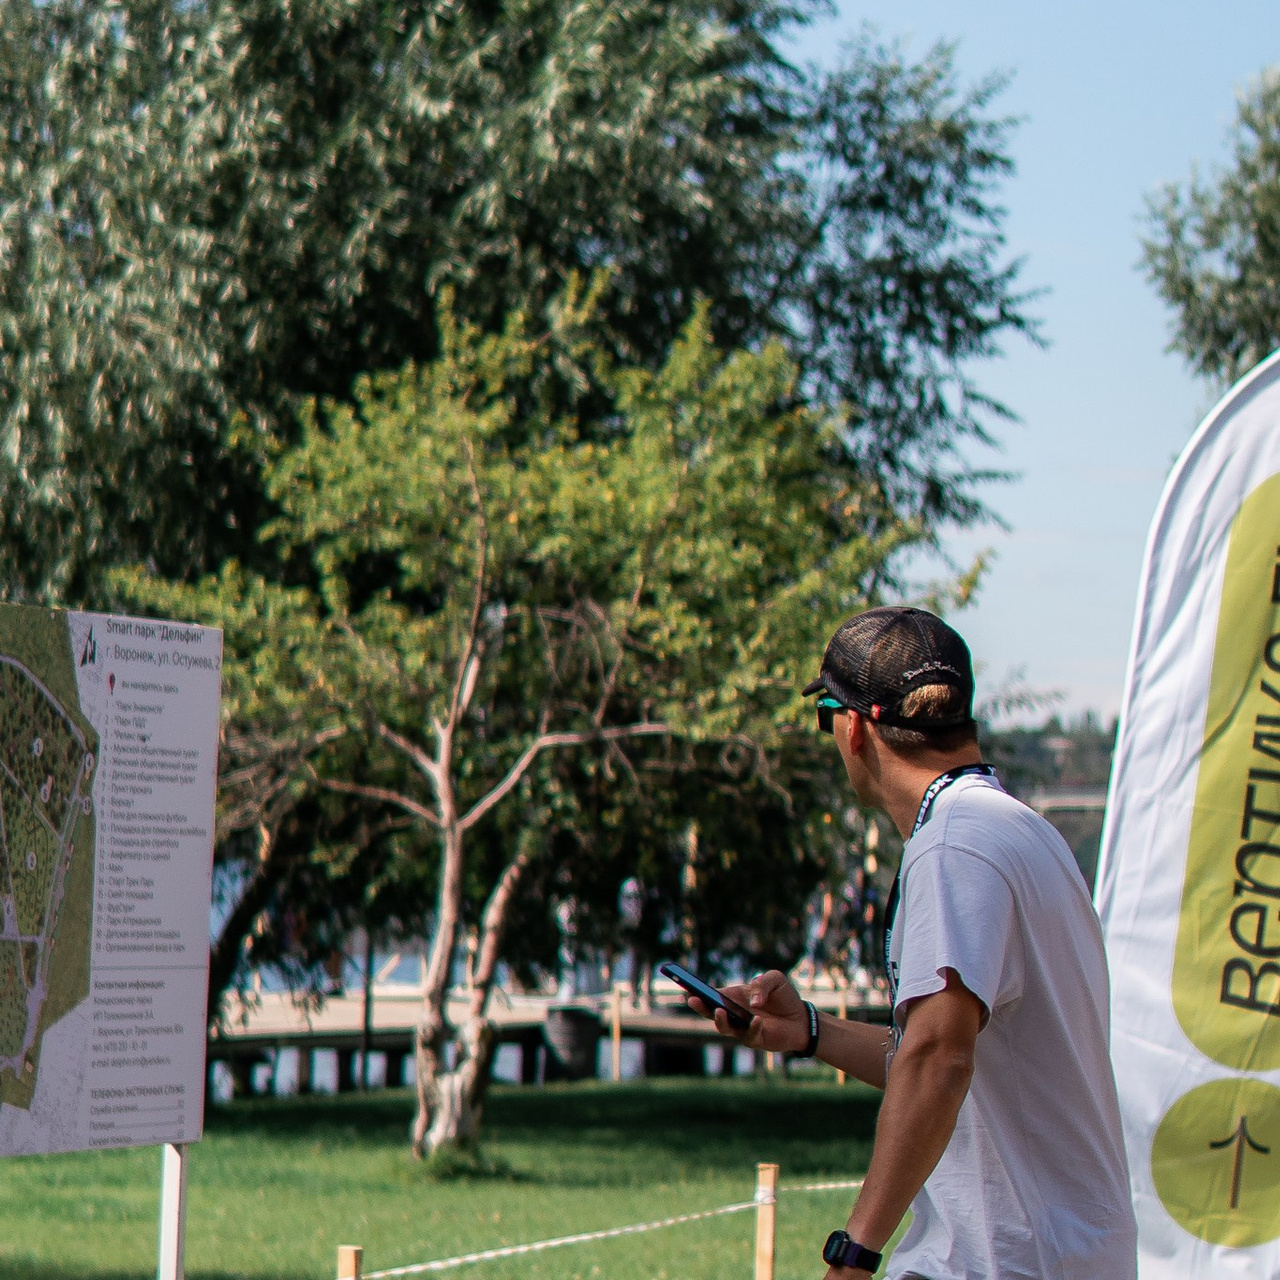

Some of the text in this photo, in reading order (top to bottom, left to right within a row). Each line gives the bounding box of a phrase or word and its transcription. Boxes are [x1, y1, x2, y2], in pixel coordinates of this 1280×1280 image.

[107, 619, 204, 644] Smart парк "Дельфин"
[106, 647, 112, 658] г.
[115, 644, 156, 665] Воронеж,
[158, 652, 170, 667] ул.
[173, 651, 214, 670] Остужева,
